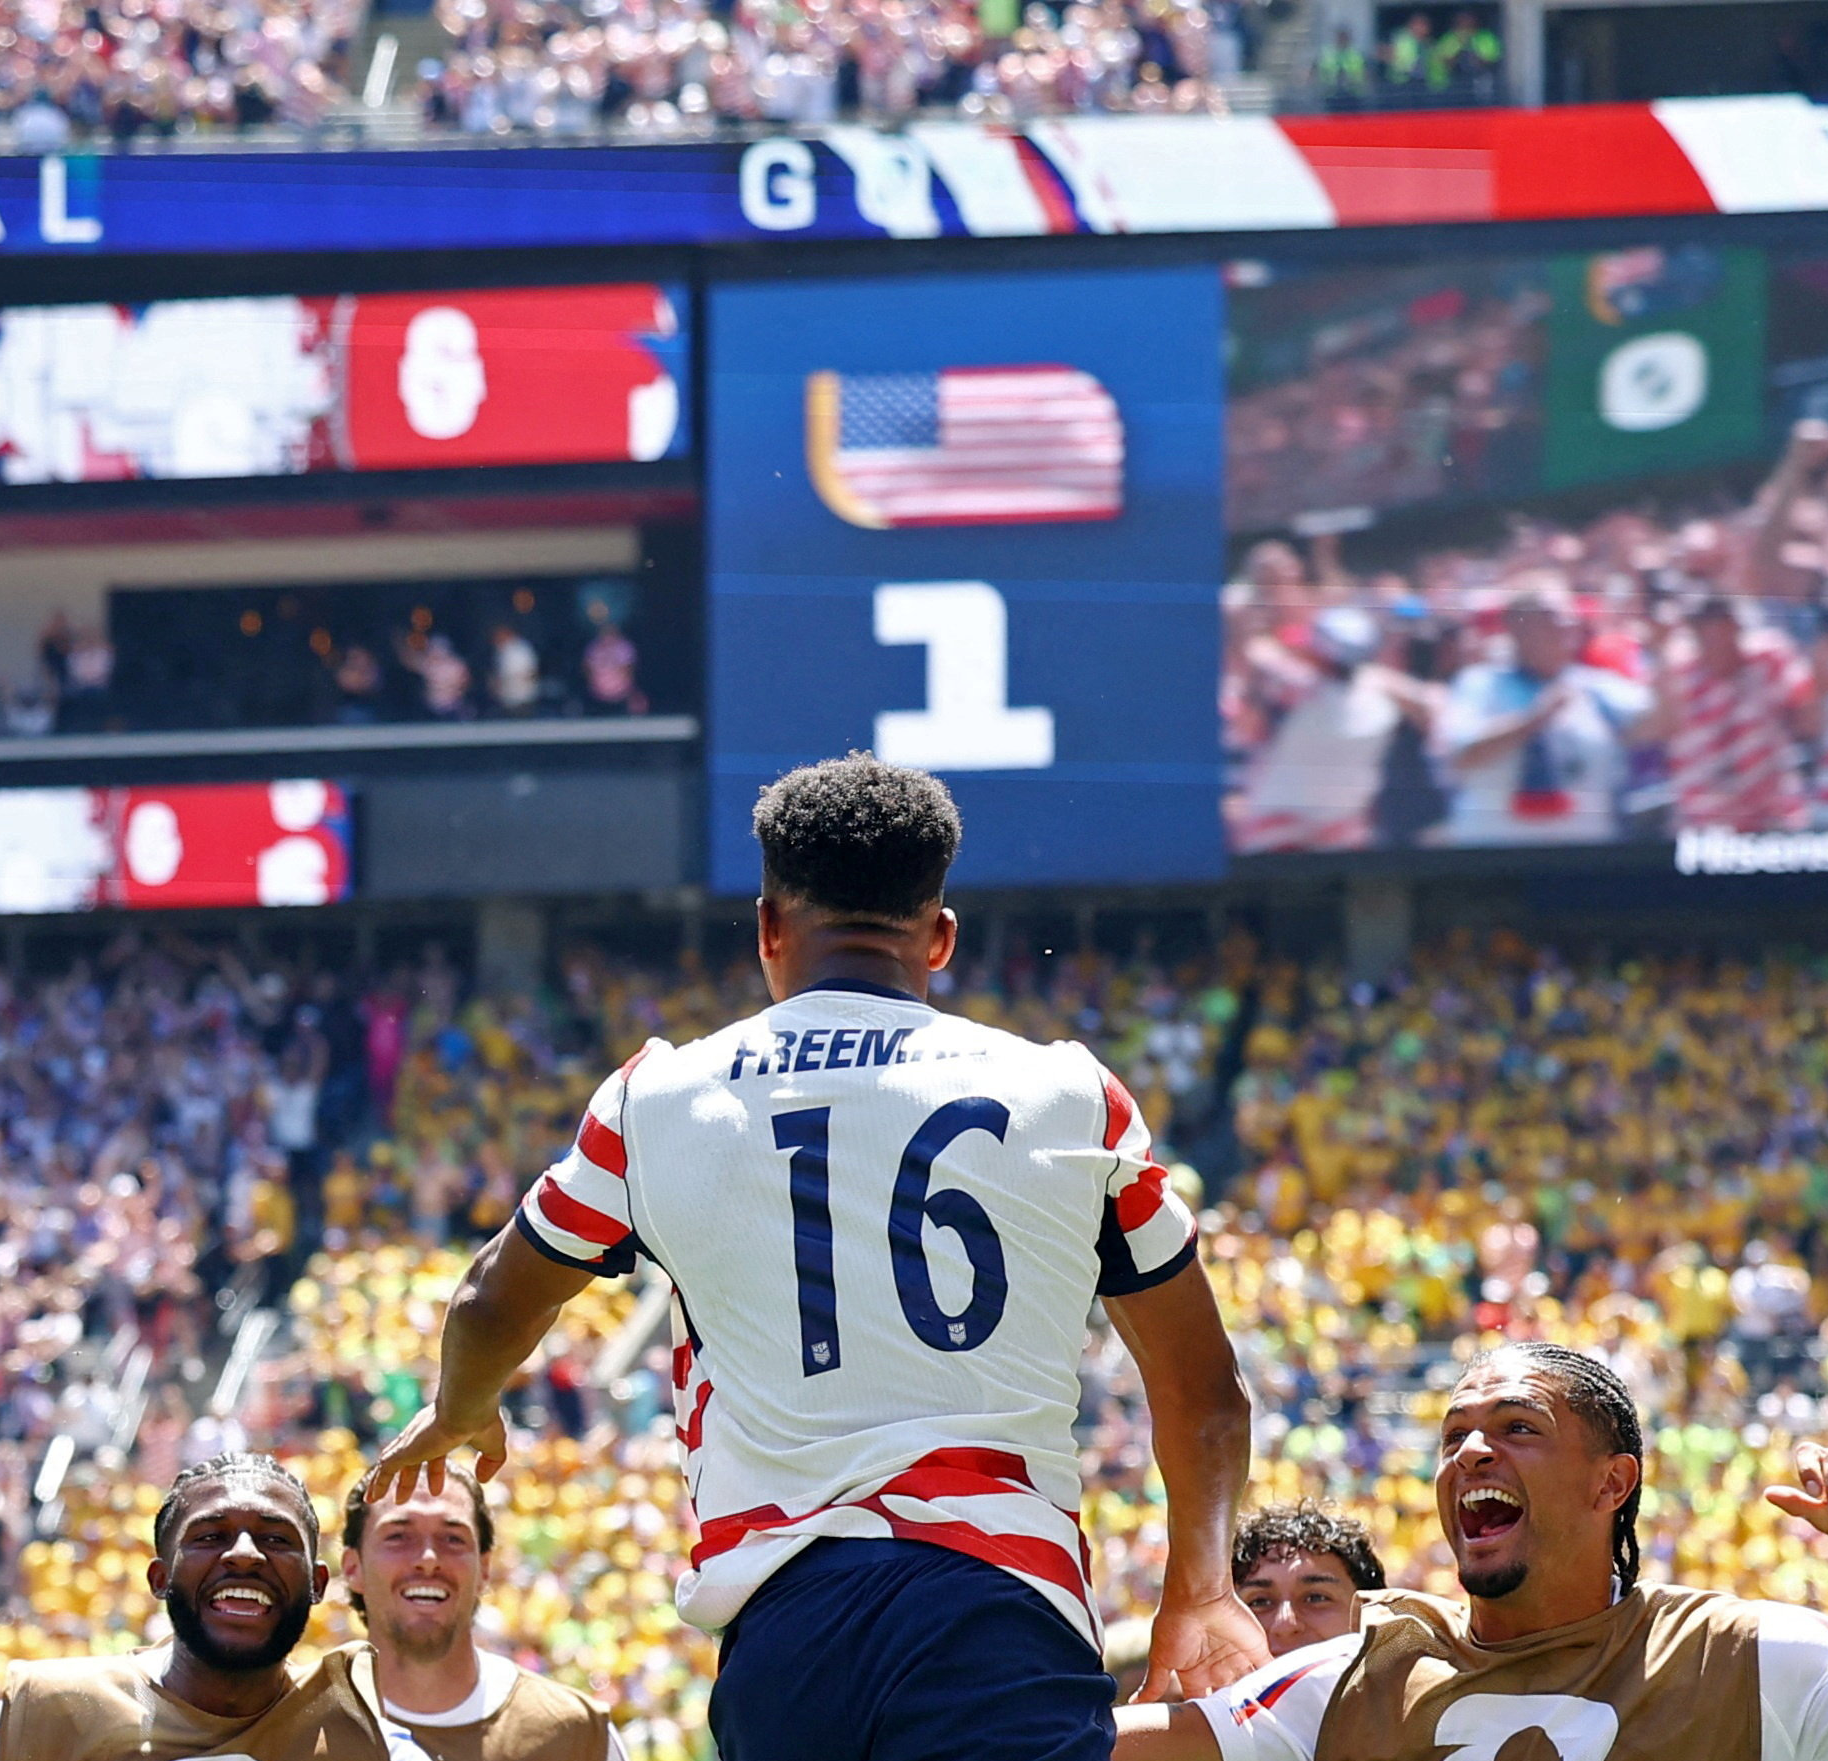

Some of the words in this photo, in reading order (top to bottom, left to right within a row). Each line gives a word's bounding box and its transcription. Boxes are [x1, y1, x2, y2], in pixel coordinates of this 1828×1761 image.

[874, 579, 1055, 771] 1
[729, 1028, 986, 1081] FREEM
[771, 1096, 1011, 1378] 16
